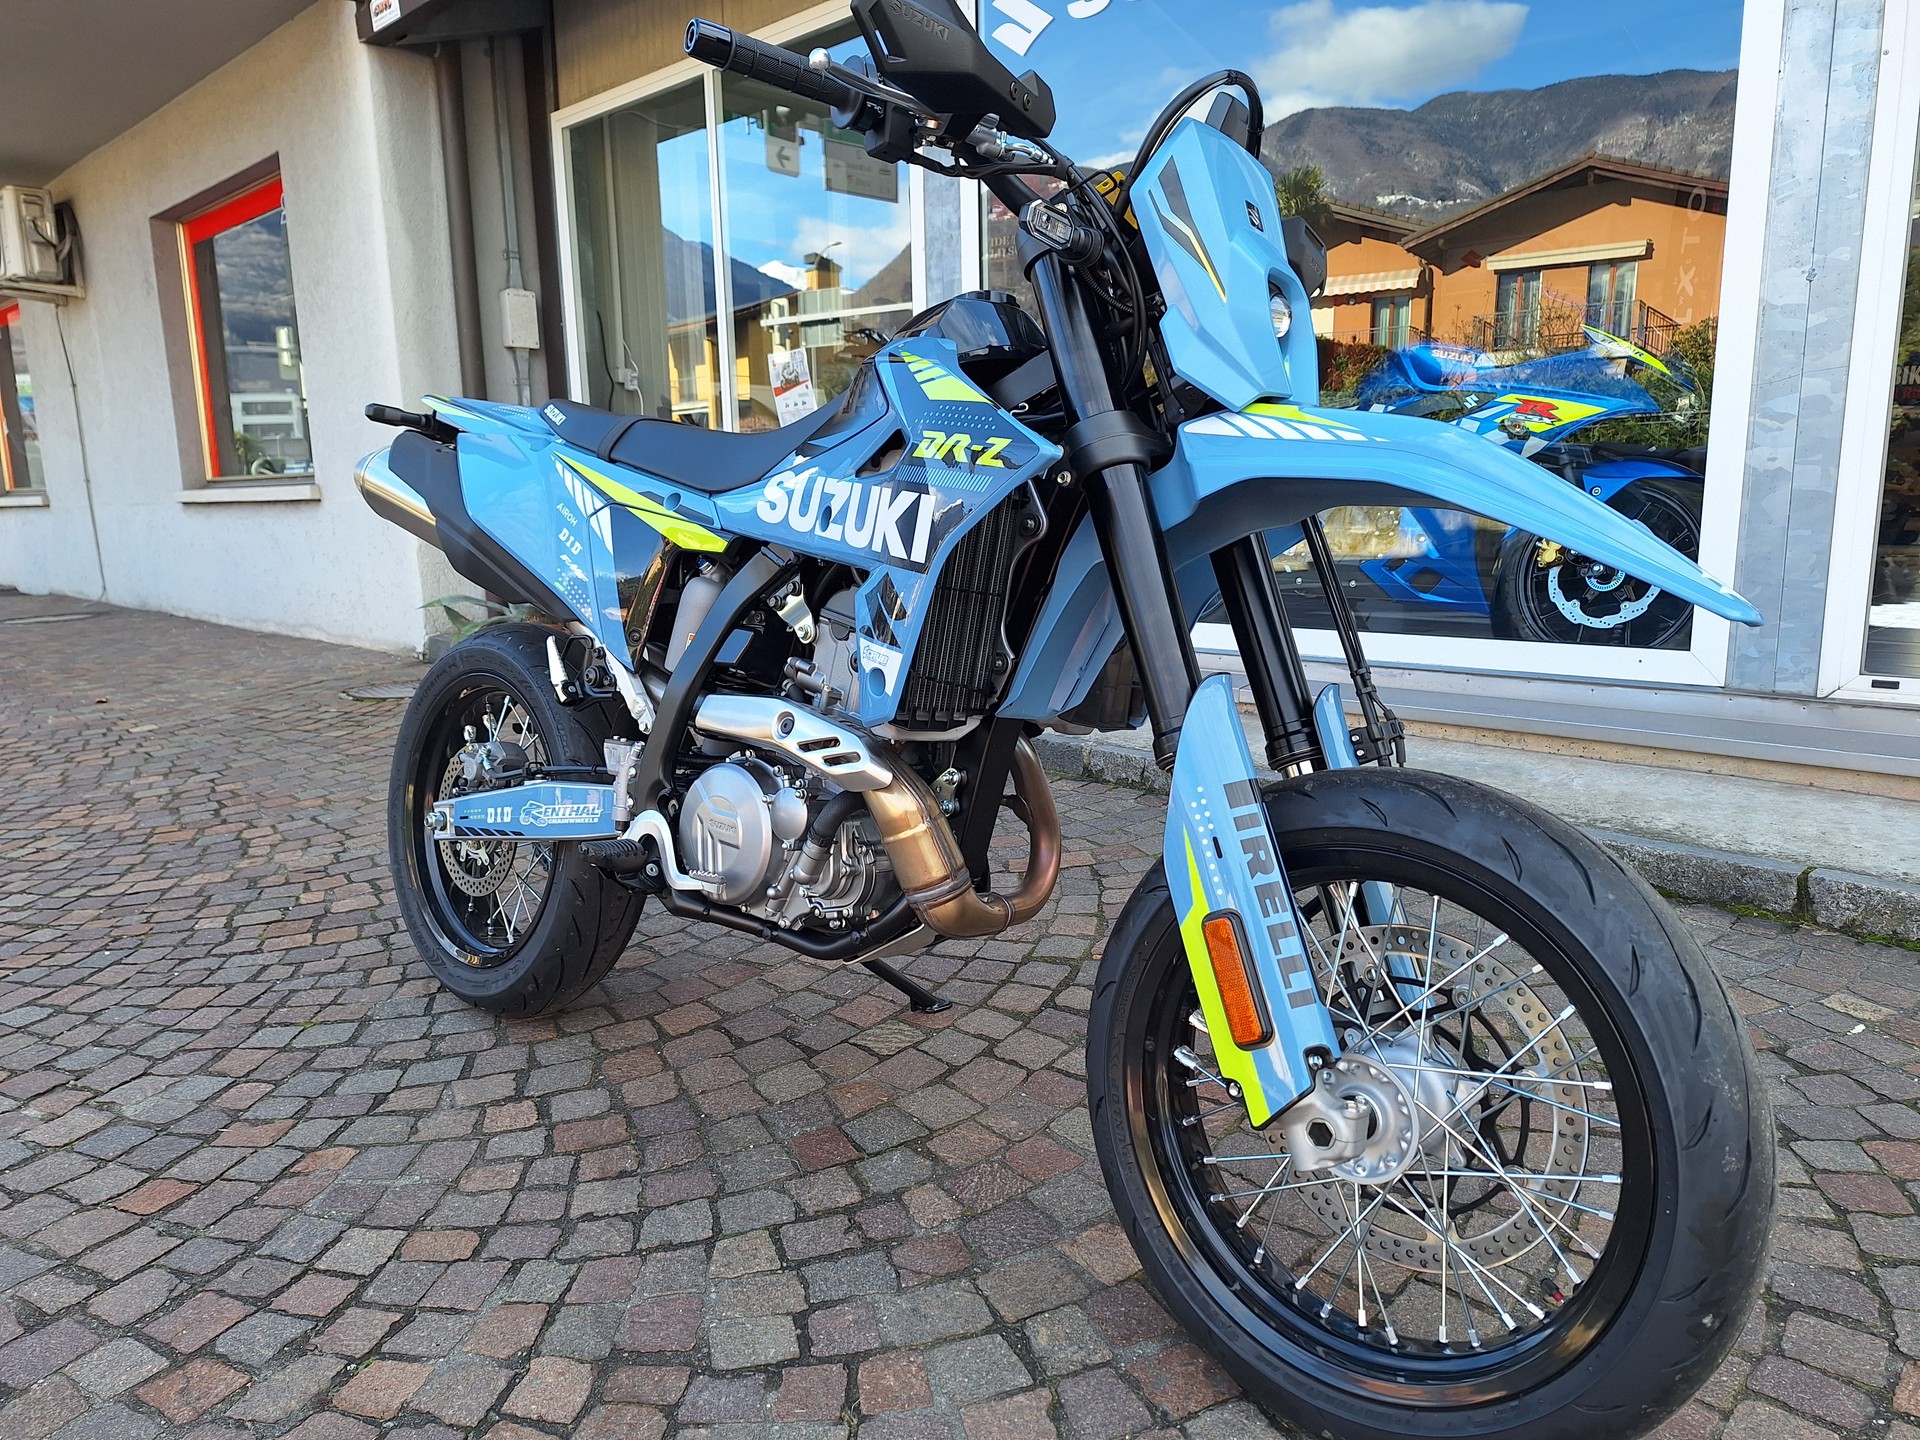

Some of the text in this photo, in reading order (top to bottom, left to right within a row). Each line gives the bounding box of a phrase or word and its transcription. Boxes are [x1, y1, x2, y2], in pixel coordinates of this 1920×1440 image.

[889, 0, 950, 41] SUZUKI
[1431, 349, 1475, 364] SUZUKI
[543, 403, 567, 427] SUZUKI
[912, 430, 1013, 468] DR-Z
[556, 502, 578, 528] AIROH
[756, 470, 937, 564] SUZUKI
